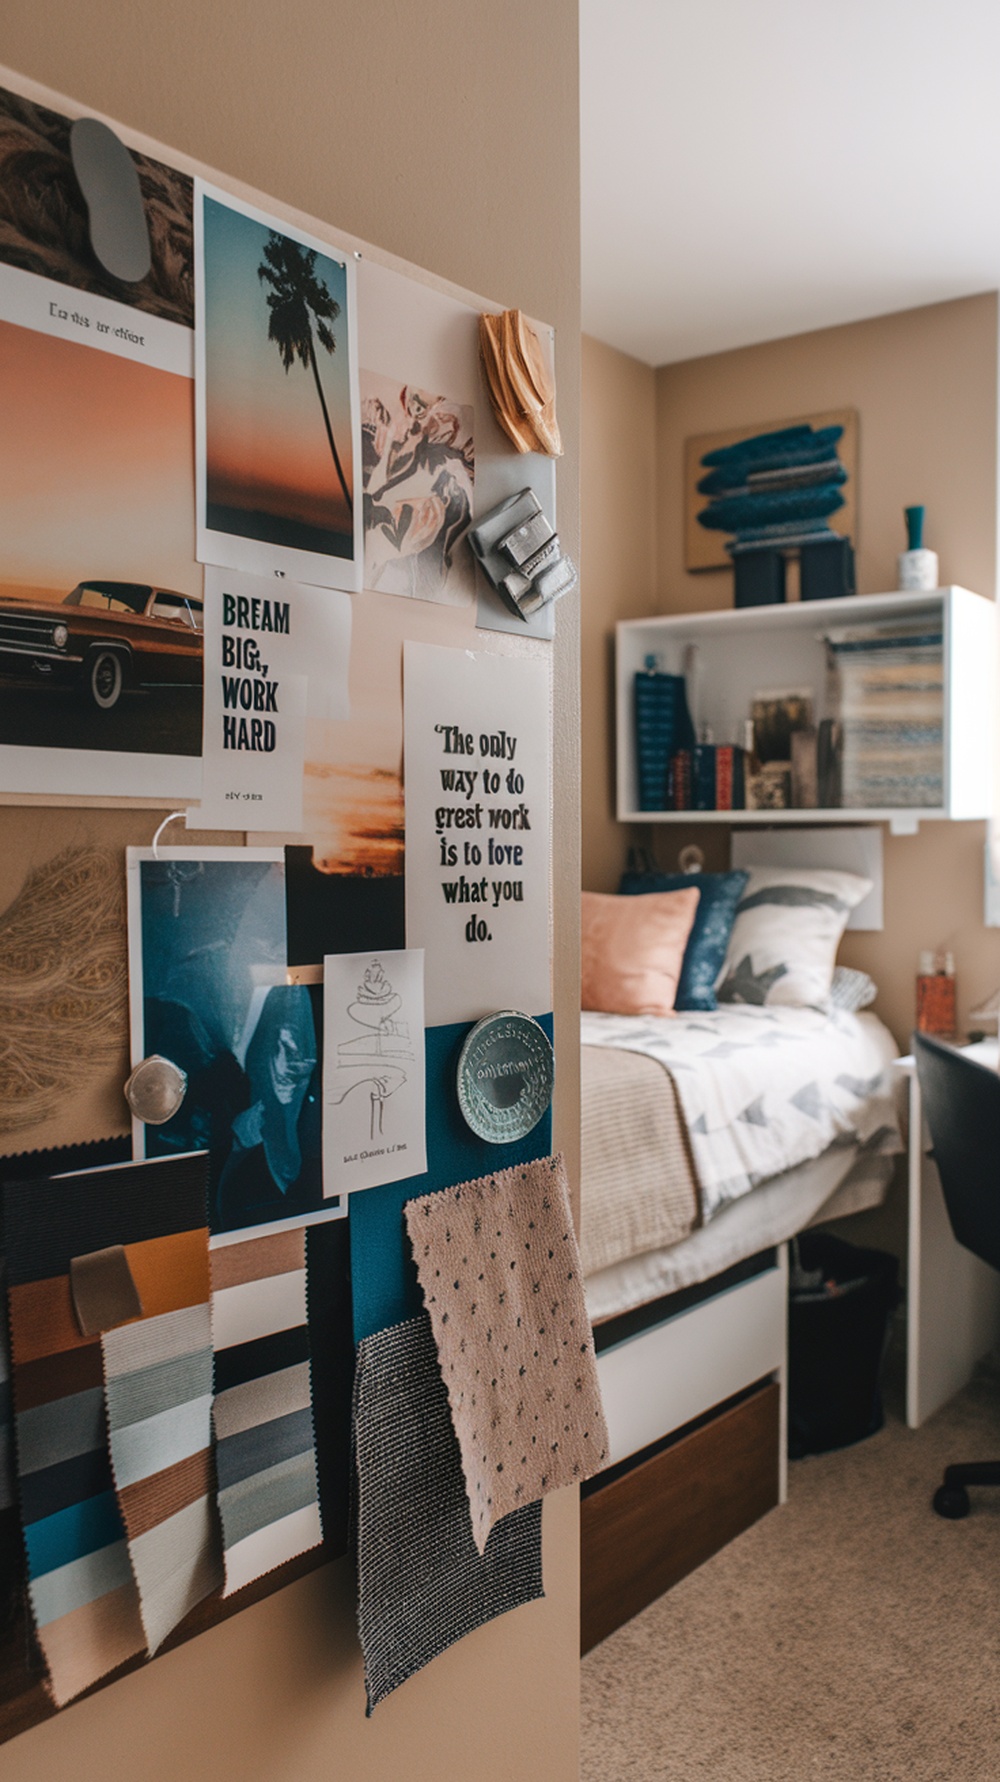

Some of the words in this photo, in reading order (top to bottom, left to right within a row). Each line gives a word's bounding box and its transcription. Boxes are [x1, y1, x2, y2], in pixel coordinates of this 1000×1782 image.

[221, 675, 279, 713] WORK
[222, 714, 276, 753] HARD
[479, 730, 517, 761] only
[440, 769, 478, 800] way
[482, 769, 500, 795] to
[505, 768, 525, 795] do
[488, 803, 531, 831] work
[440, 837, 458, 867] is
[463, 841, 482, 866] to
[488, 837, 524, 866] love
[441, 875, 488, 904] what
[491, 880, 524, 908] you
[465, 913, 493, 944] do.
